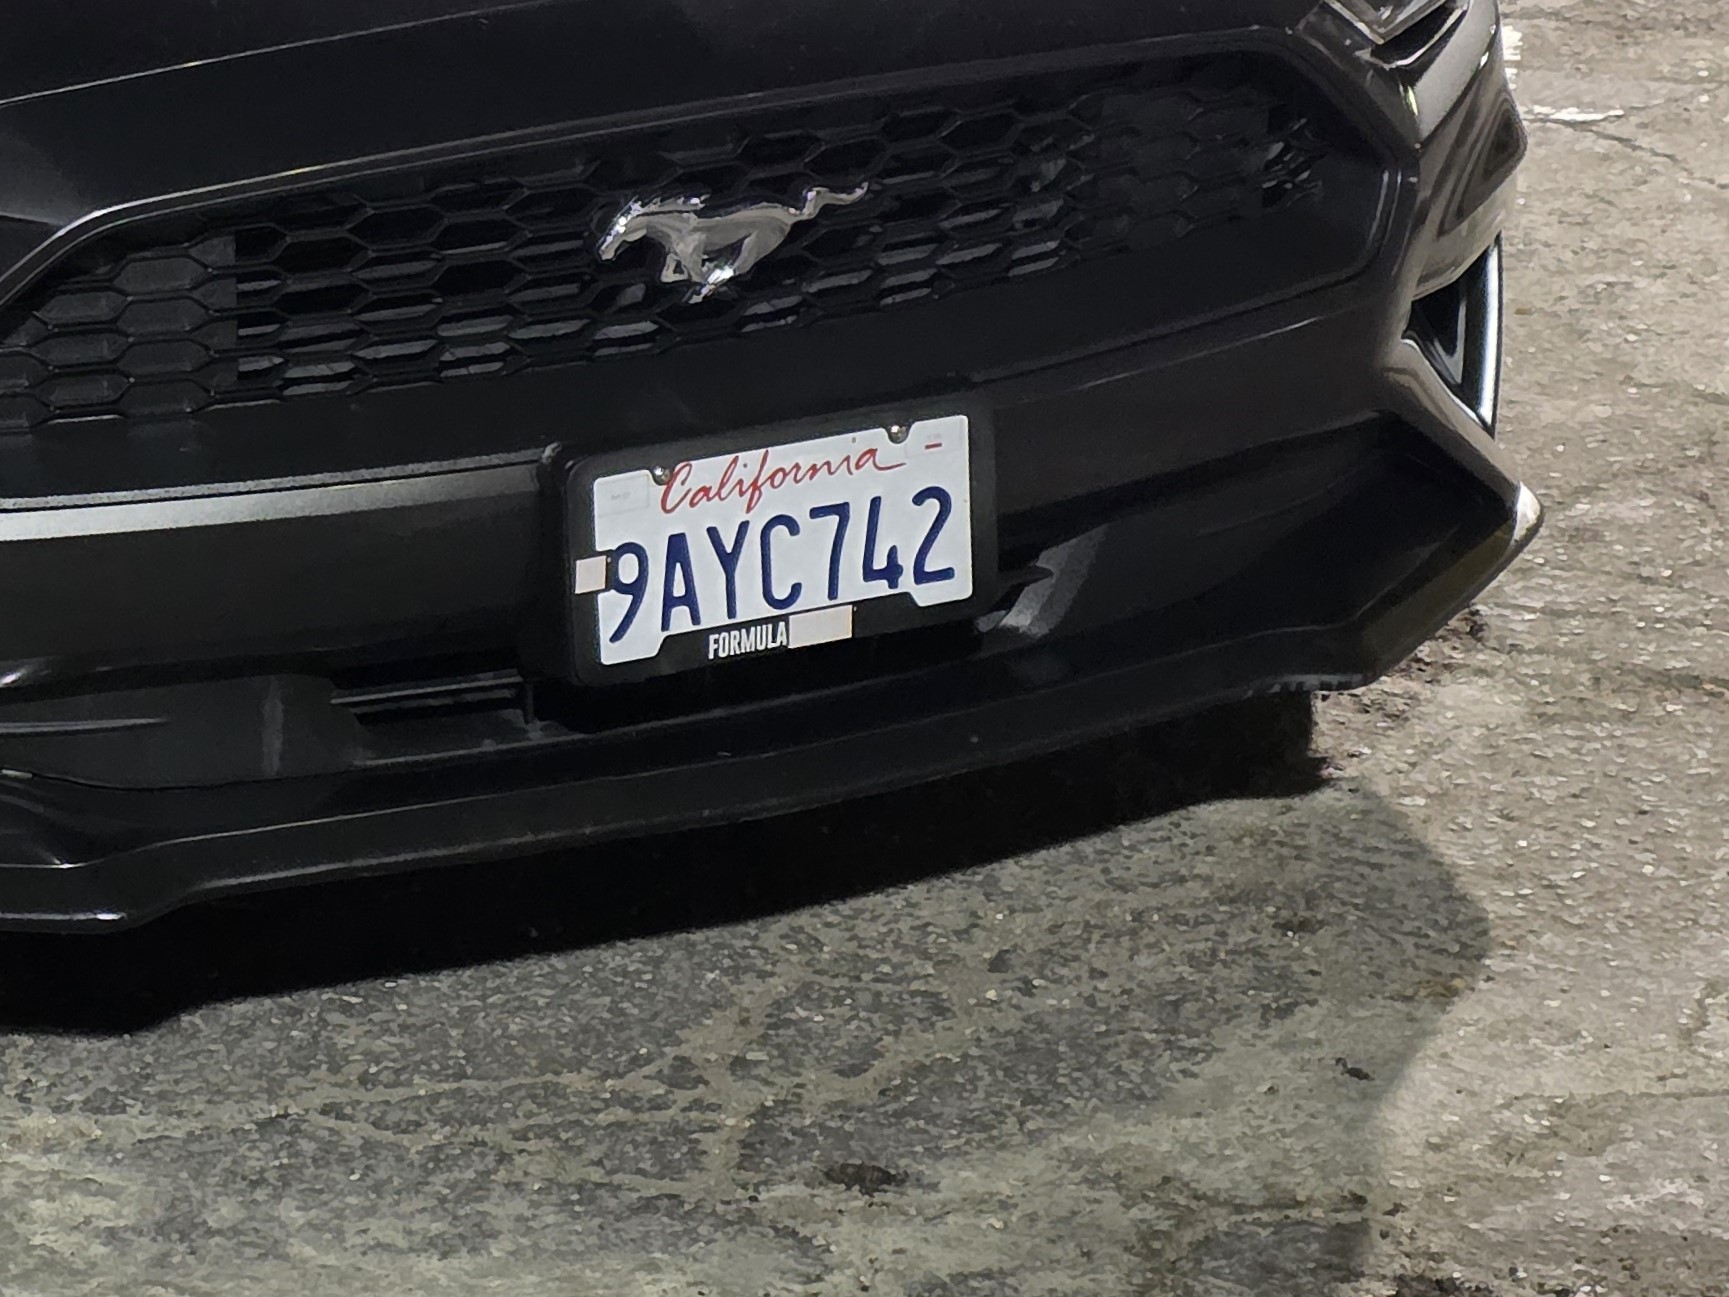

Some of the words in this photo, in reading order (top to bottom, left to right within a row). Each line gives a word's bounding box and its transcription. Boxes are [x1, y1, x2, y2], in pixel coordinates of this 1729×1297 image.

[660, 446, 907, 515] California
[609, 485, 956, 644] 9AYC742
[708, 621, 788, 660] FORMULA
